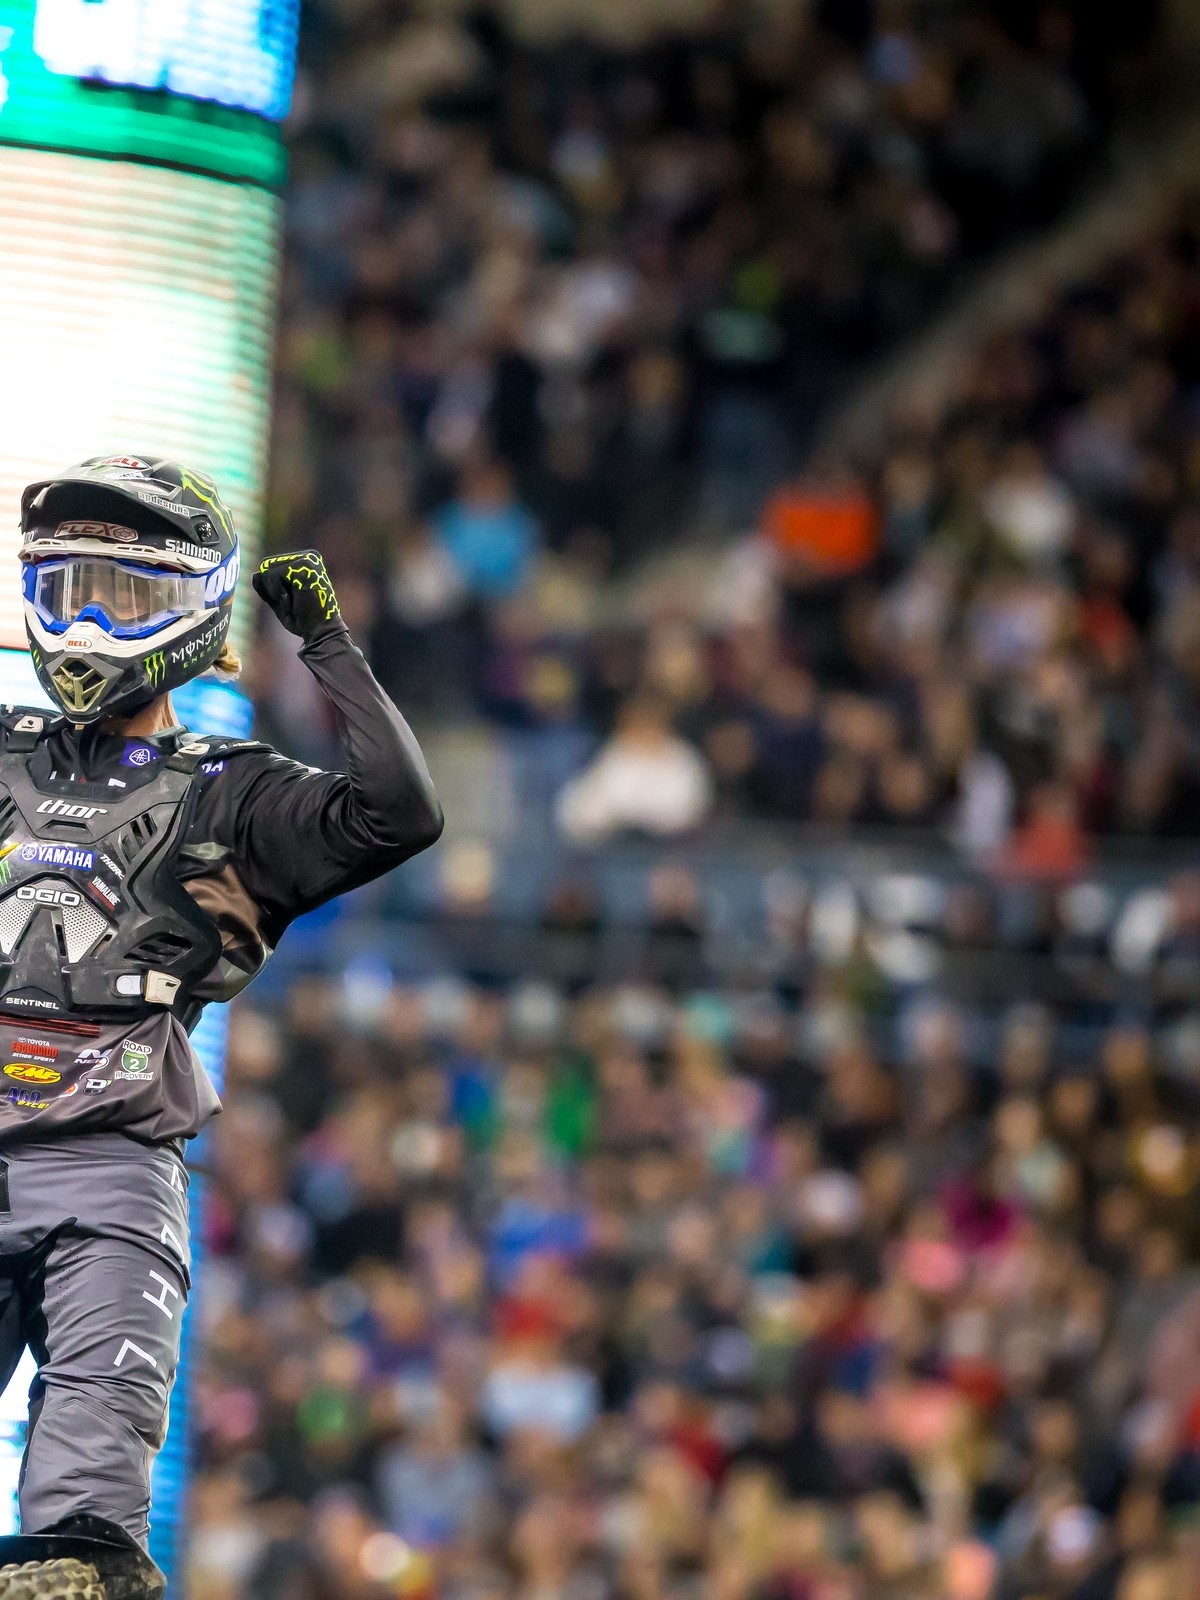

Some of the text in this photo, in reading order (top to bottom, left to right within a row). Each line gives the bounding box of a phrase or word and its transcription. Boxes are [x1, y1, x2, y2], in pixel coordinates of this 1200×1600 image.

[165, 538, 222, 564] SHIMANO
[67, 640, 89, 648] BELL
[36, 799, 108, 819] thor
[38, 845, 93, 869] YAMAHA
[99, 853, 125, 880] THOR
[17, 886, 81, 907] OGIO
[91, 875, 121, 906] YAMALUBE
[5, 997, 60, 1010] SENTINEL
[27, 1038, 50, 1047] TOYOTA
[123, 1041, 151, 1053] ROAD
[129, 1058, 140, 1070] 2
[4, 1065, 61, 1080] FMF
[115, 1072, 153, 1080] RECOVERY
